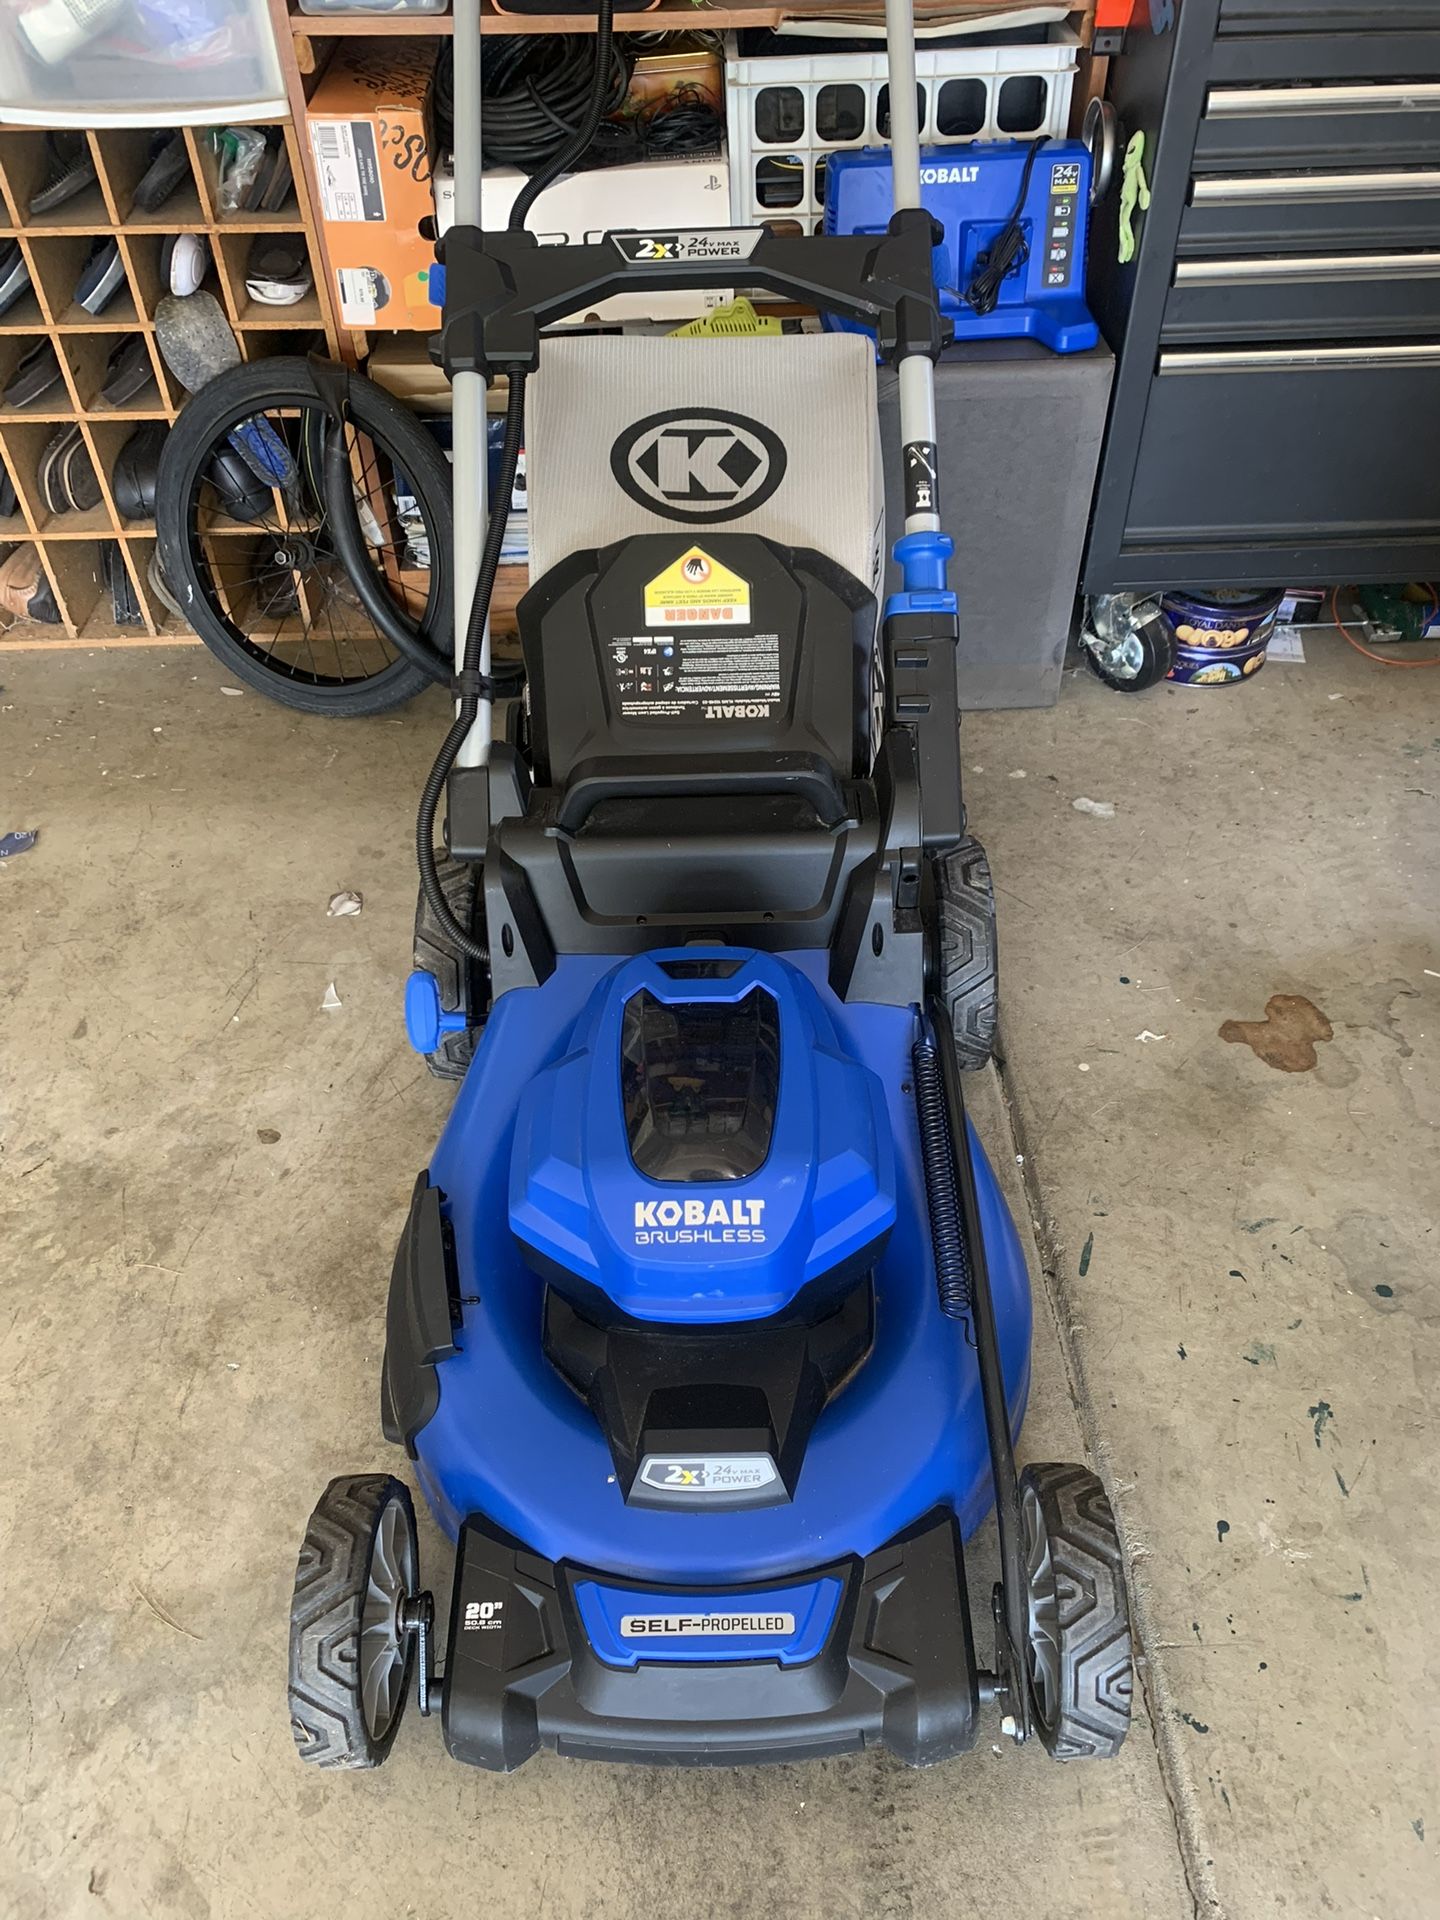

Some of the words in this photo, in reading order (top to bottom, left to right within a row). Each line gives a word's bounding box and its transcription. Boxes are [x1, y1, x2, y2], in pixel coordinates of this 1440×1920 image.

[688, 247, 740, 257] POWER
[664, 607, 733, 622] DANGER
[705, 704, 770, 718] KOBALT
[635, 1199, 765, 1228] KOBALT
[635, 1229, 766, 1245] BRUSHLESS
[713, 1475, 761, 1484] POWER
[630, 1616, 784, 1633] SELF-PROPELLED
